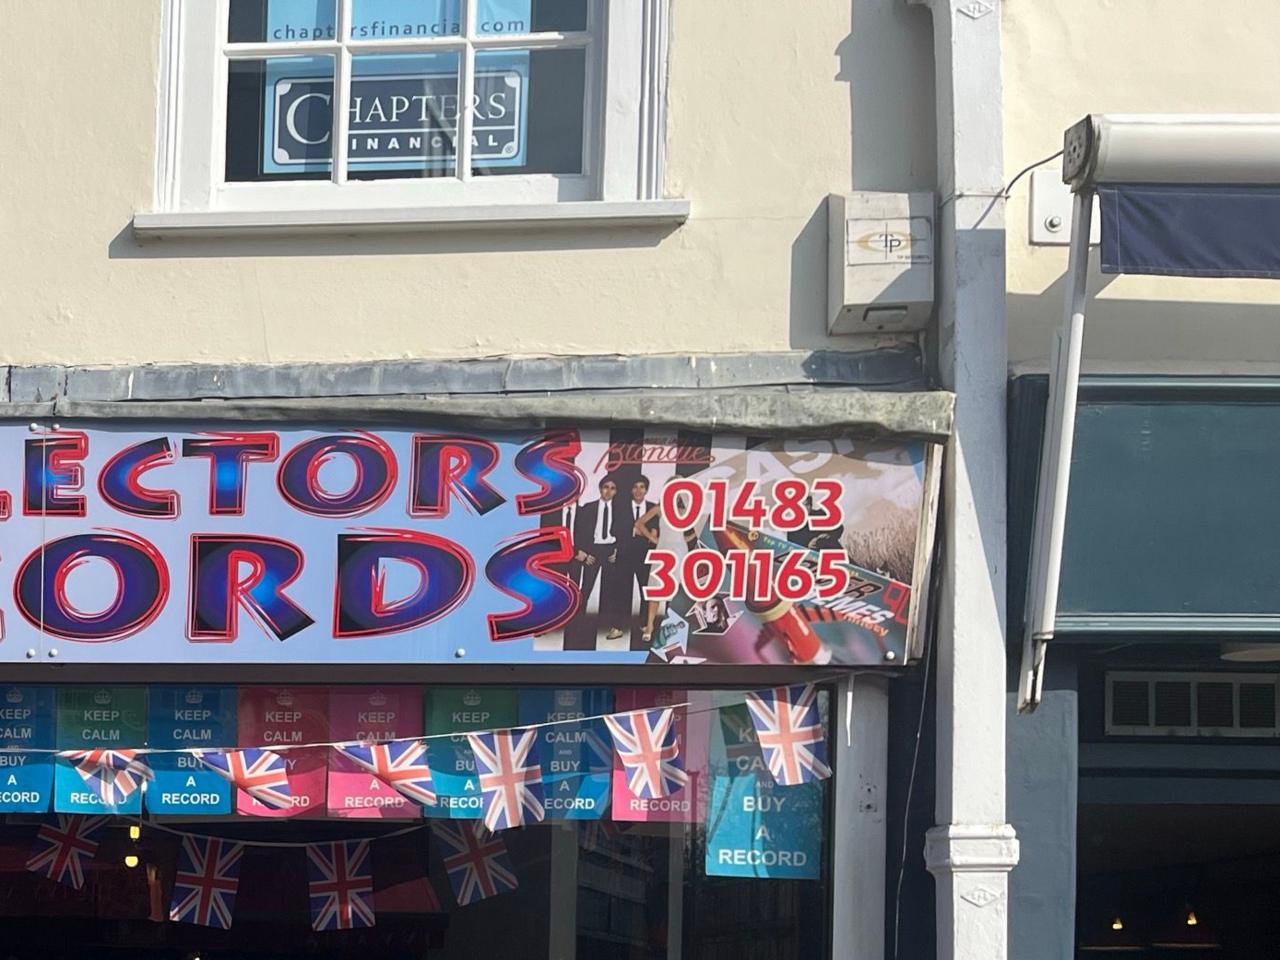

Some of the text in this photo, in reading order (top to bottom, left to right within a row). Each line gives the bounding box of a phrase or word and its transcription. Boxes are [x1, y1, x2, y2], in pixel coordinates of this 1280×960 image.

[661, 477, 845, 532] 01483
[643, 548, 851, 602] 301165
[83, 709, 120, 722] KEEP
[174, 710, 212, 721] KEEP
[265, 711, 302, 723] KEEP
[358, 712, 396, 723] KEEP
[452, 711, 491, 723] KEEP
[547, 712, 586, 723] KEEP
[81, 729, 120, 741] CALM
[173, 728, 212, 740] CALM
[263, 730, 303, 742] CALM
[356, 731, 396, 741] CALM
[545, 731, 587, 743] CALM
[0, 755, 27, 767] BUY
[456, 760, 475, 771] BU
[550, 760, 581, 772] BUY
[7, 775, 17, 786] A
[186, 776, 196, 787] A
[370, 779, 380, 790] A
[464, 780, 475, 791] A
[559, 781, 570, 791] A
[162, 793, 220, 805] RECORD
[345, 796, 405, 808] RECORD
[543, 798, 595, 810] ECORD
[743, 796, 787, 812] BUY
[630, 799, 691, 812] RECORD
[755, 827, 771, 841] A
[719, 849, 808, 867] RECORD
